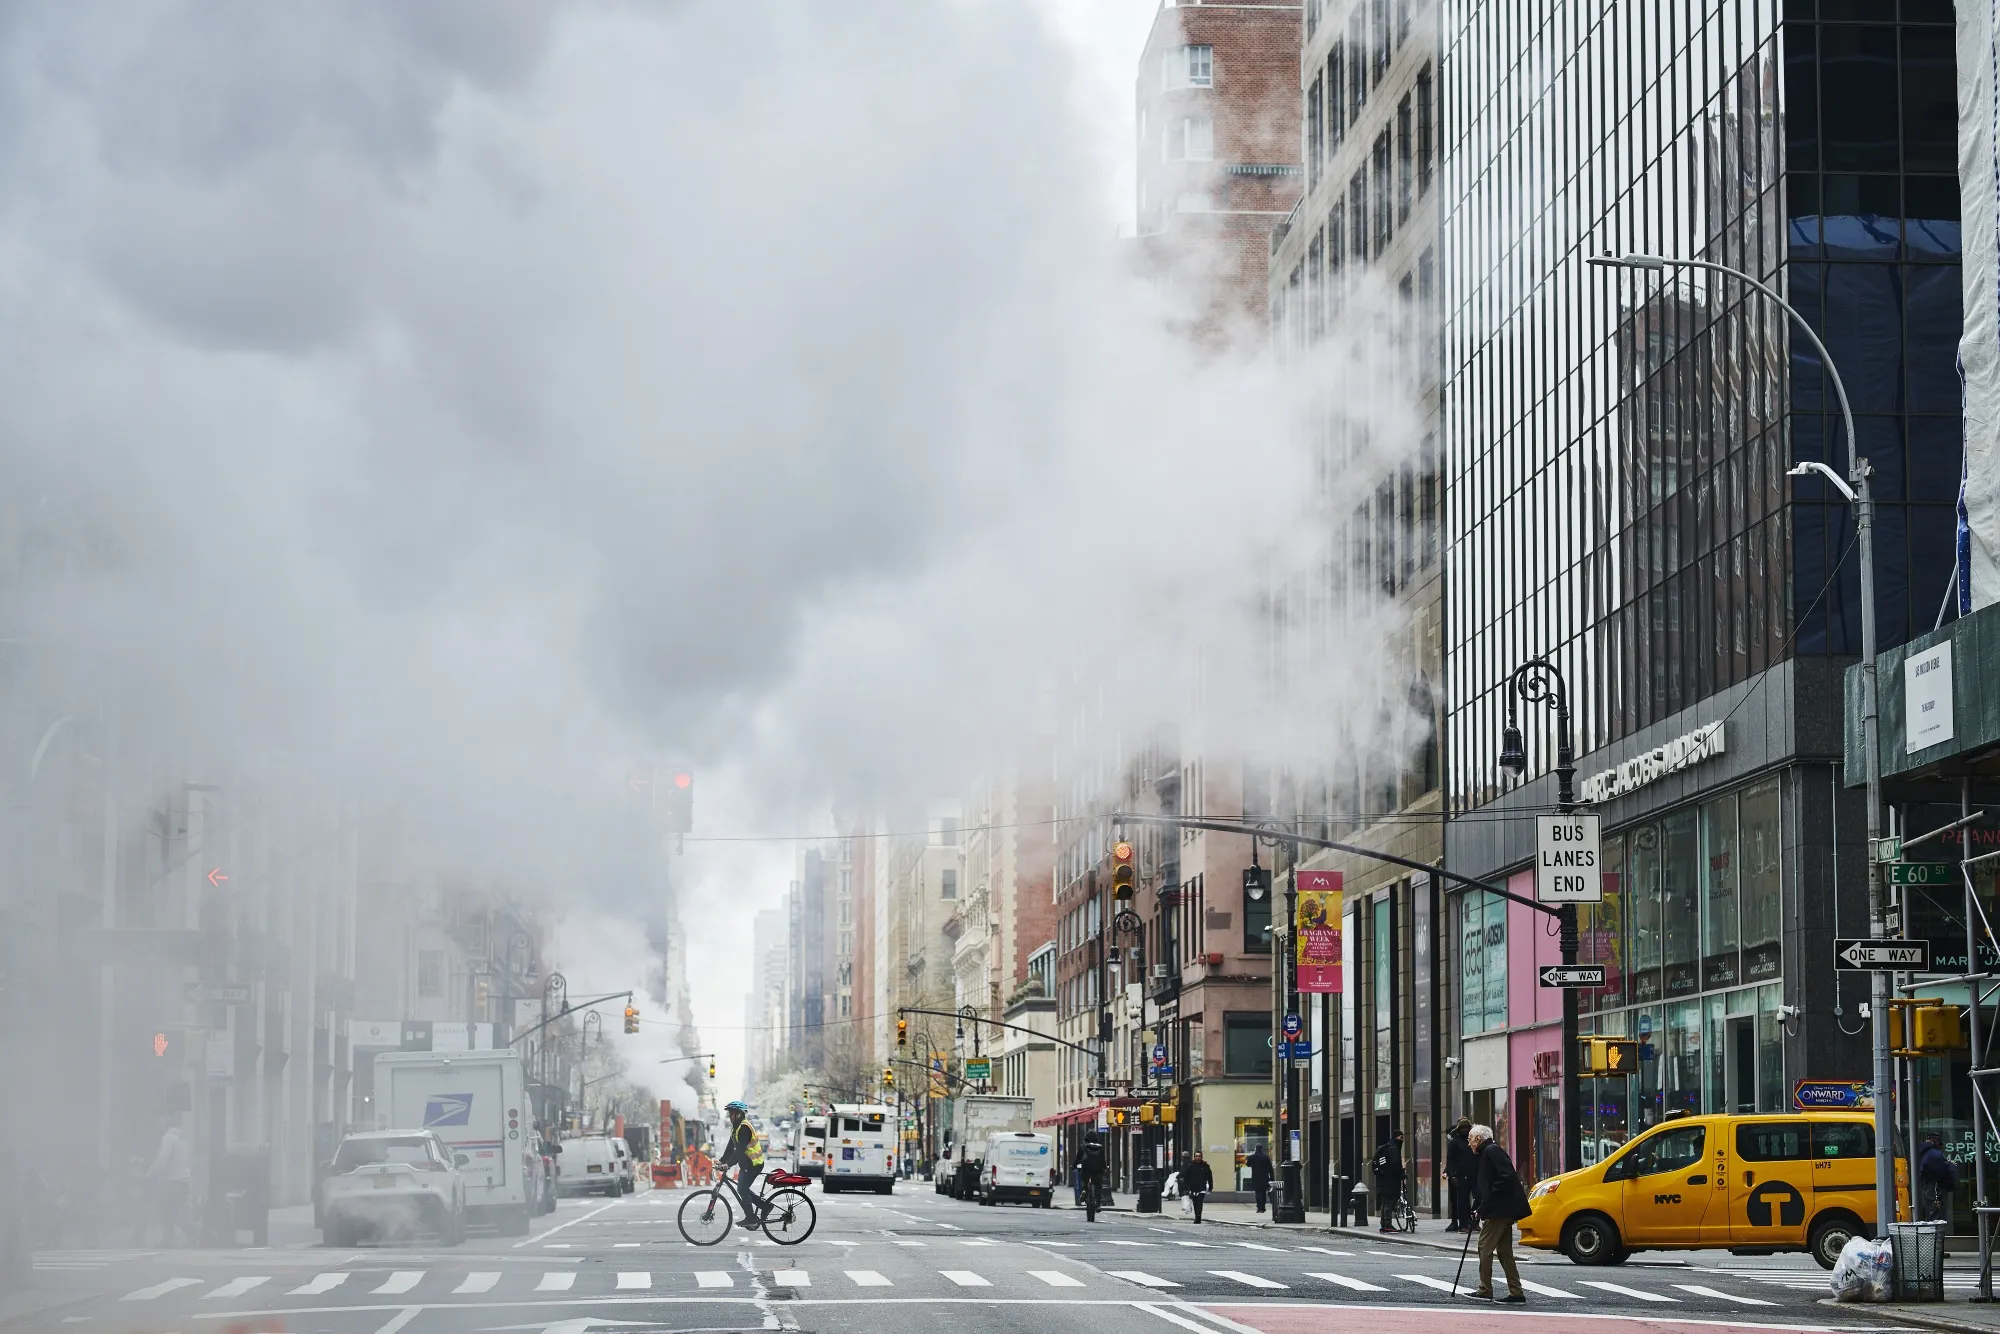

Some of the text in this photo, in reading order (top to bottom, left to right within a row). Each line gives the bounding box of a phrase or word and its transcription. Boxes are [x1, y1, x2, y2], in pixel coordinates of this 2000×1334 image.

[1581, 720, 1725, 802] MARC JACOBS MADISON
[1552, 825, 1584, 842] BUS
[1543, 850, 1595, 867] LANES
[1891, 865, 1946, 883] E 60 ST
[1554, 875, 1585, 892] END
[1299, 929, 1340, 937] FRAGRANCE
[1483, 922, 1505, 949] MADISON
[1848, 949, 1917, 961] ONE WAY
[1935, 956, 1968, 966] MAR
[1548, 971, 1600, 982] ONE WAY
[1802, 1090, 1846, 1101] ONWARD
[1945, 1142, 2000, 1152] SPRNG
[1945, 1153, 1974, 1163] MAR
[1654, 1194, 1682, 1204] NYC
[1760, 1193, 1791, 1226] T
